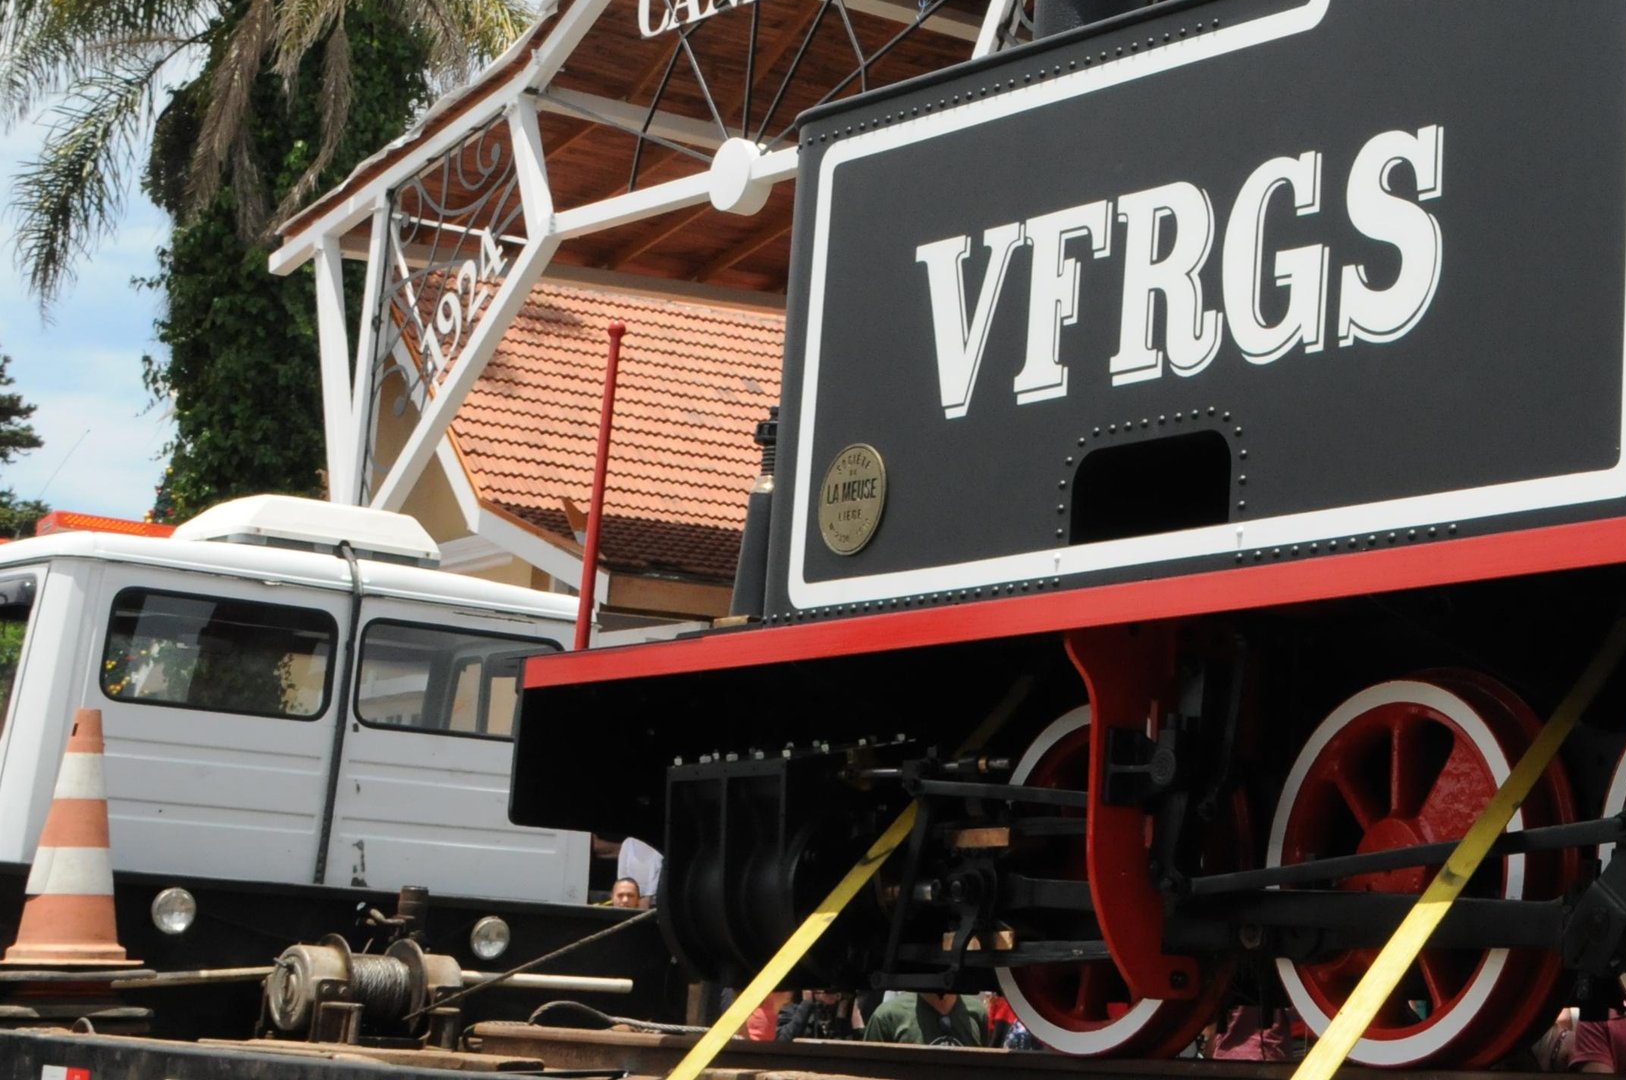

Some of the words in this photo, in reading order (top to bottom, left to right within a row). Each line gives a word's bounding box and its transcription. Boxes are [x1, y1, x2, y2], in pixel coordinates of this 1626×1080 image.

[420, 226, 508, 384] 1924
[915, 124, 1444, 420] VFRGS
[826, 483, 840, 505] LA
[841, 477, 878, 503] MEUSE
